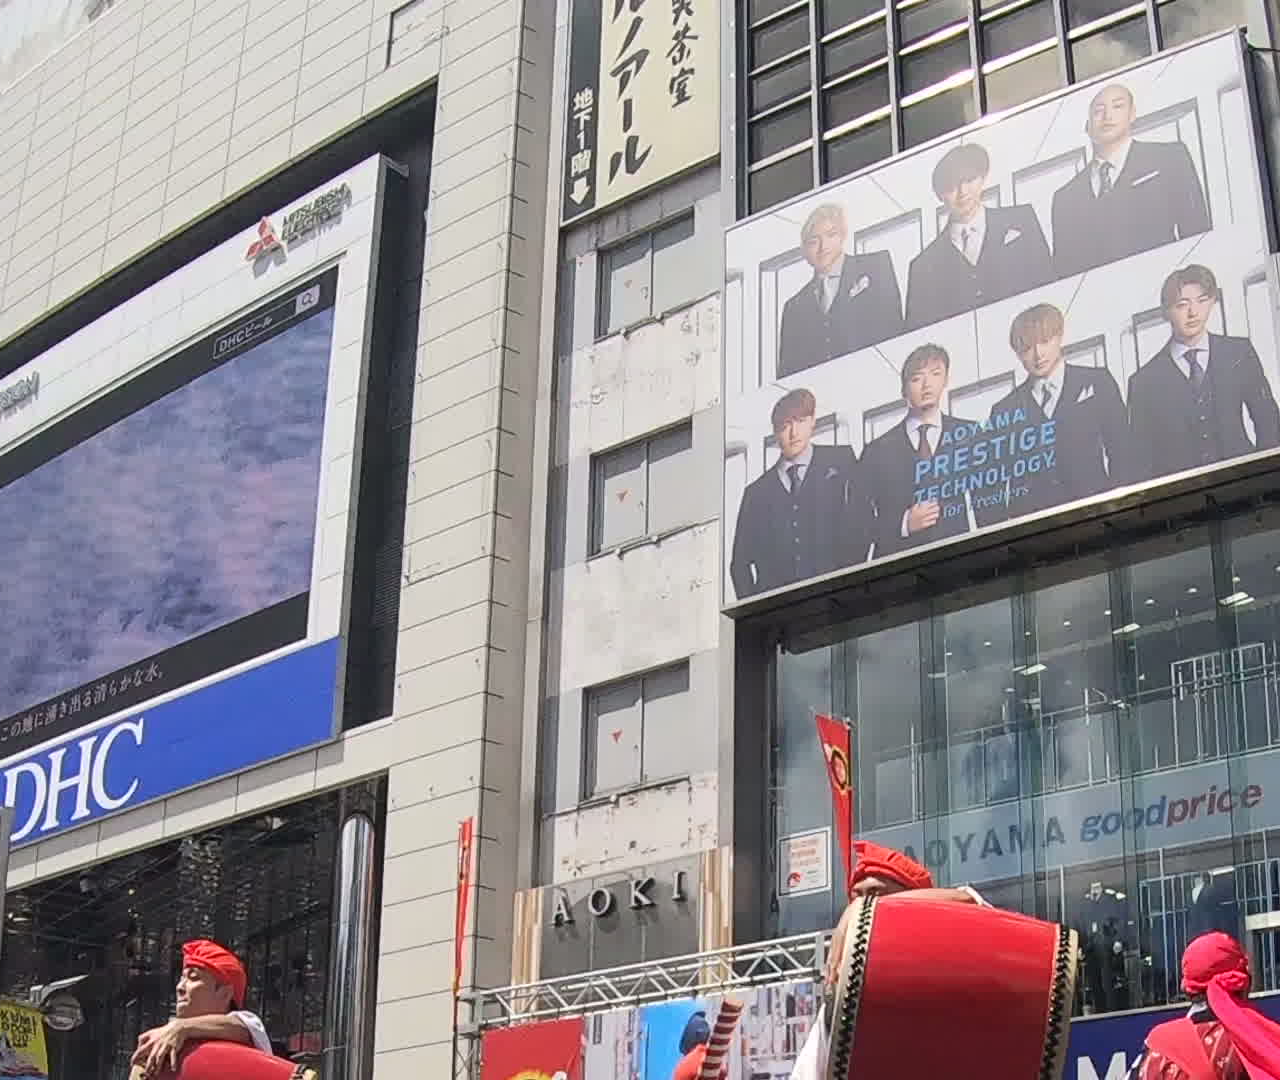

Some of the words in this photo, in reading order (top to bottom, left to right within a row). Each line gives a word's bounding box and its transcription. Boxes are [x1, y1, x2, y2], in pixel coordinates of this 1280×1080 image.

[915, 420, 1057, 485] PRESTIGE
[941, 408, 1027, 446] AOYAMA
[4, 718, 144, 842] DHC
[905, 815, 1065, 868] AOYAMA
[552, 872, 686, 927] AOKI
